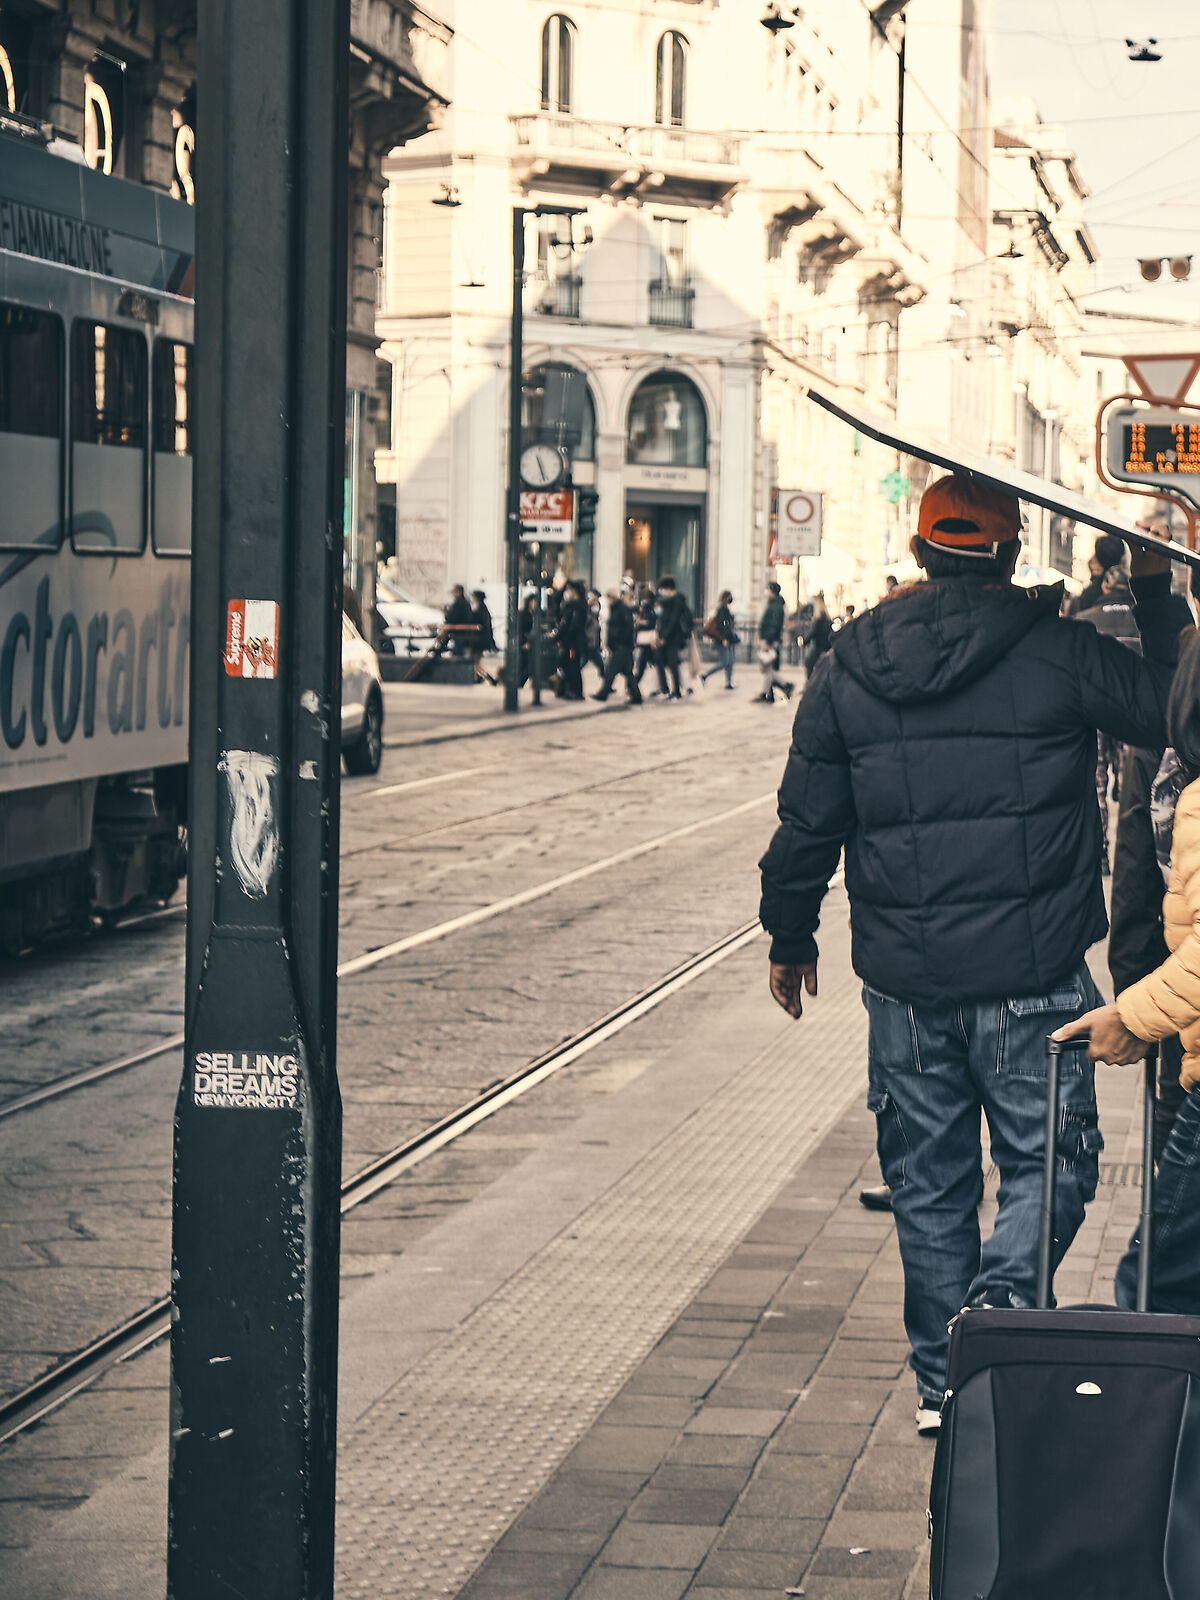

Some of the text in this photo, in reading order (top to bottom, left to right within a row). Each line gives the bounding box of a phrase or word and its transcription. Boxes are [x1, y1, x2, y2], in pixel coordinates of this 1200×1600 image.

[520, 492, 566, 509] KFC
[226, 611, 242, 666] Supreme
[194, 1052, 298, 1076] SELLING
[194, 1073, 298, 1097] DREAMS
